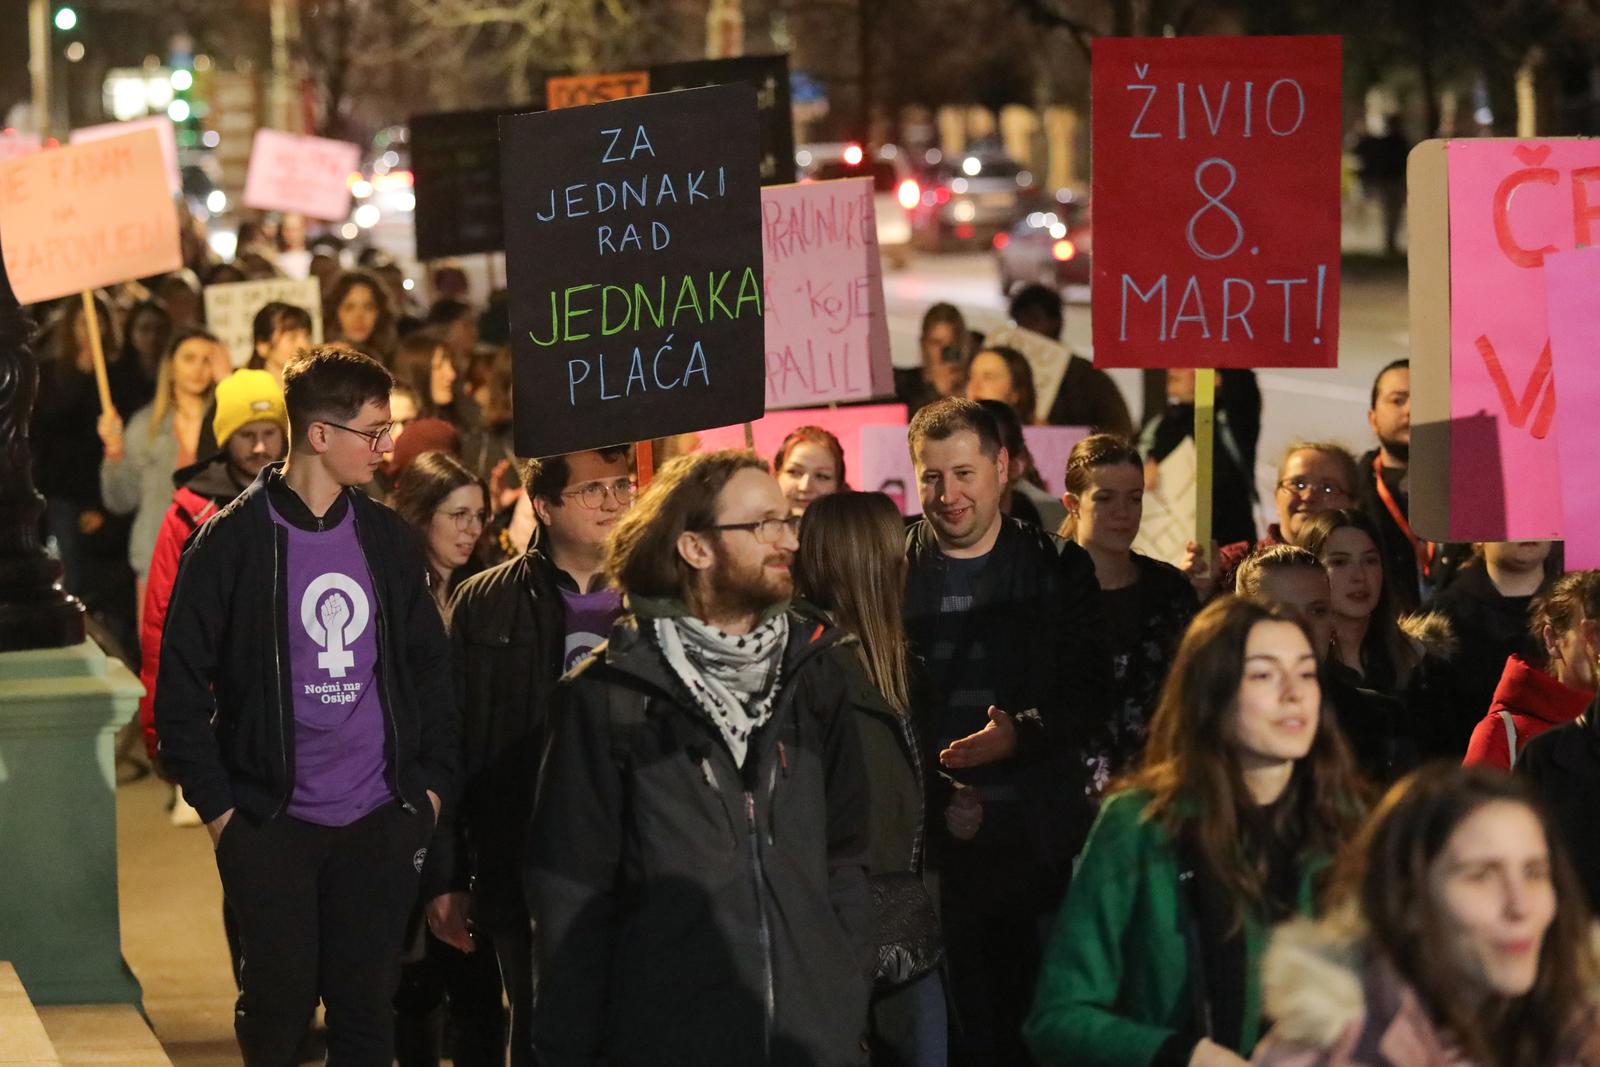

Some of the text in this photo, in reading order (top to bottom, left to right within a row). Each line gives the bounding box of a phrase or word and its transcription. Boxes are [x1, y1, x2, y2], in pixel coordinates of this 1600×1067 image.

[1126, 62, 1305, 140] ŽIVIO
[600, 124, 656, 163] ZA
[536, 165, 725, 222] JEDNAKI
[1186, 157, 1260, 260] 8.
[597, 221, 670, 256] RAD
[528, 266, 762, 346] JEDNAKA
[1118, 264, 1327, 345] MART!
[568, 333, 710, 406] PLAĆA
[304, 681, 363, 694] Noćni ma
[321, 691, 357, 705] Osijek
